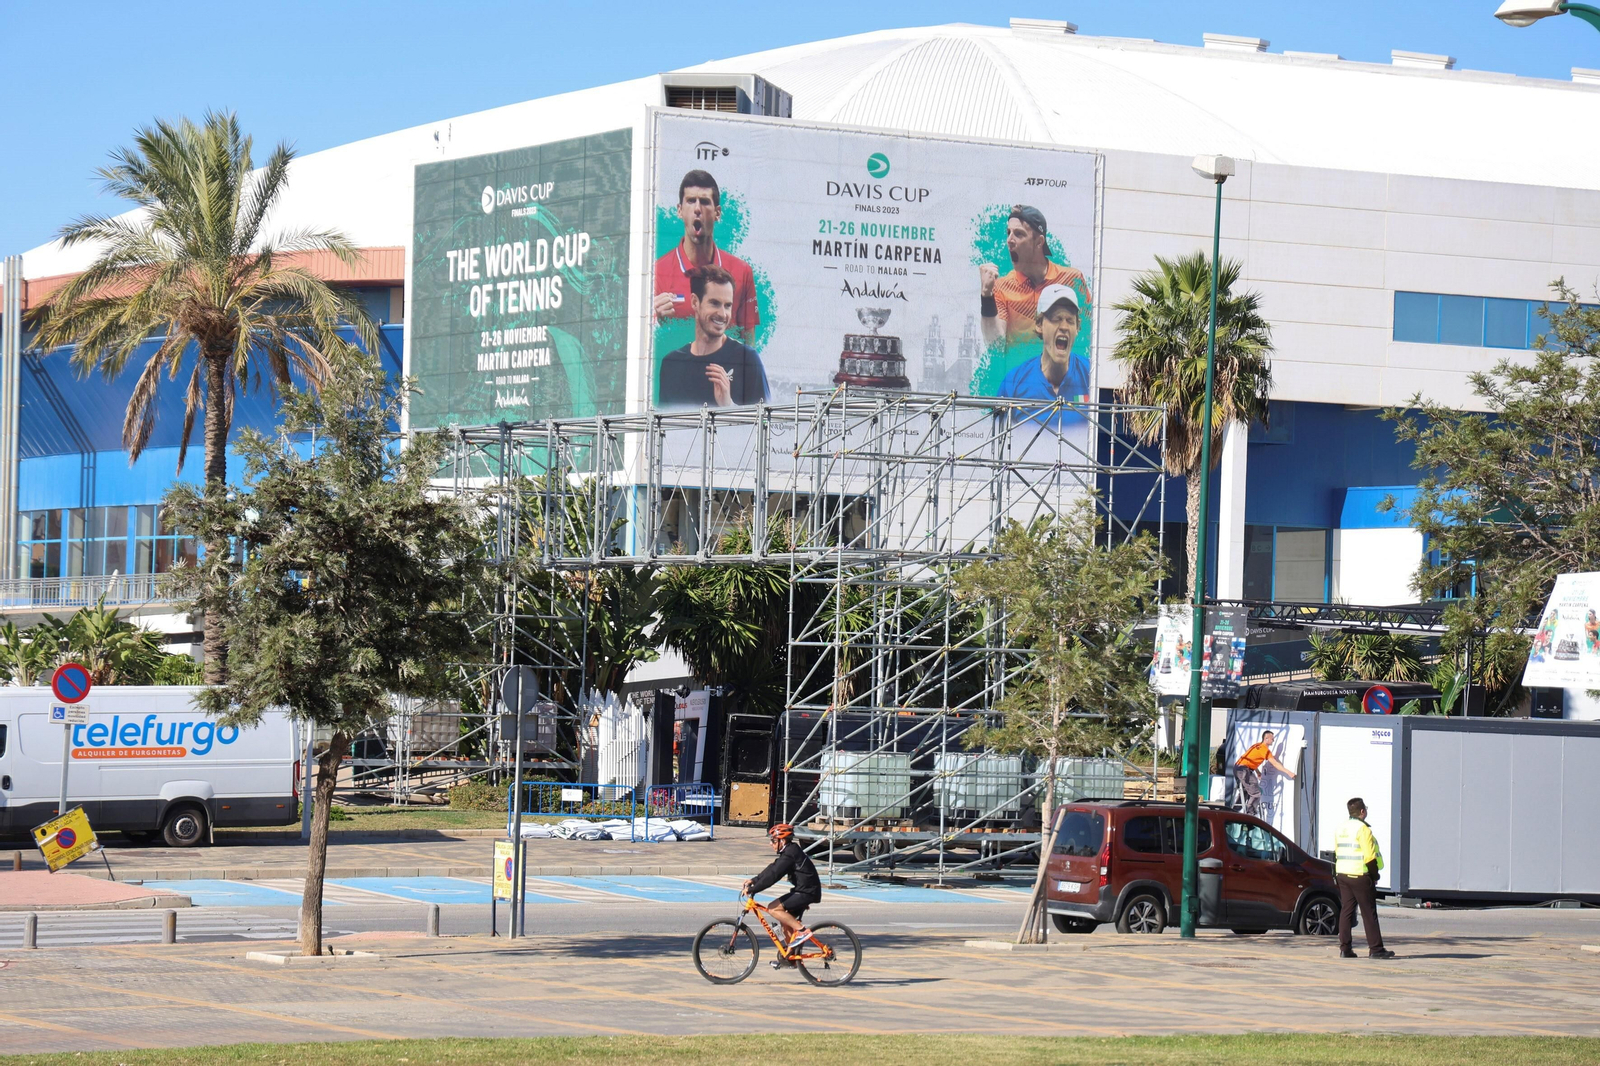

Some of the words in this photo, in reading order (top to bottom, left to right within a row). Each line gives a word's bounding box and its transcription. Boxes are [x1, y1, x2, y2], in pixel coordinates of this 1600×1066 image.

[697, 148, 719, 161] ITF
[496, 185, 528, 206] DAVIS
[530, 181, 554, 201] CUP
[826, 181, 883, 199] DAVIS
[889, 186, 930, 203] CUP
[855, 204, 881, 213] FINALS
[882, 206, 900, 214] 2023
[819, 219, 855, 235] 21-26
[860, 222, 936, 241] NOVIEMBRE
[446, 247, 481, 282] THE
[484, 238, 549, 278] WORLD
[552, 232, 590, 269] CUP
[812, 238, 868, 259] MARTÍN
[875, 244, 942, 264] CARPENA
[844, 264, 863, 273] ROAD
[867, 265, 875, 274] TO
[877, 266, 908, 276] MALAGA
[469, 284, 493, 317] OF
[496, 275, 563, 315] TENNIS
[840, 278, 909, 302] Andalucía
[480, 330, 502, 347] 21-26
[503, 325, 548, 345] NOVIEMBRE
[477, 347, 509, 371] MARTÍN
[511, 347, 551, 369] CARPENA
[640, 689, 656, 697] WORL
[72, 714, 239, 756] telefurgo
[131, 748, 181, 756] FURGONETAS
